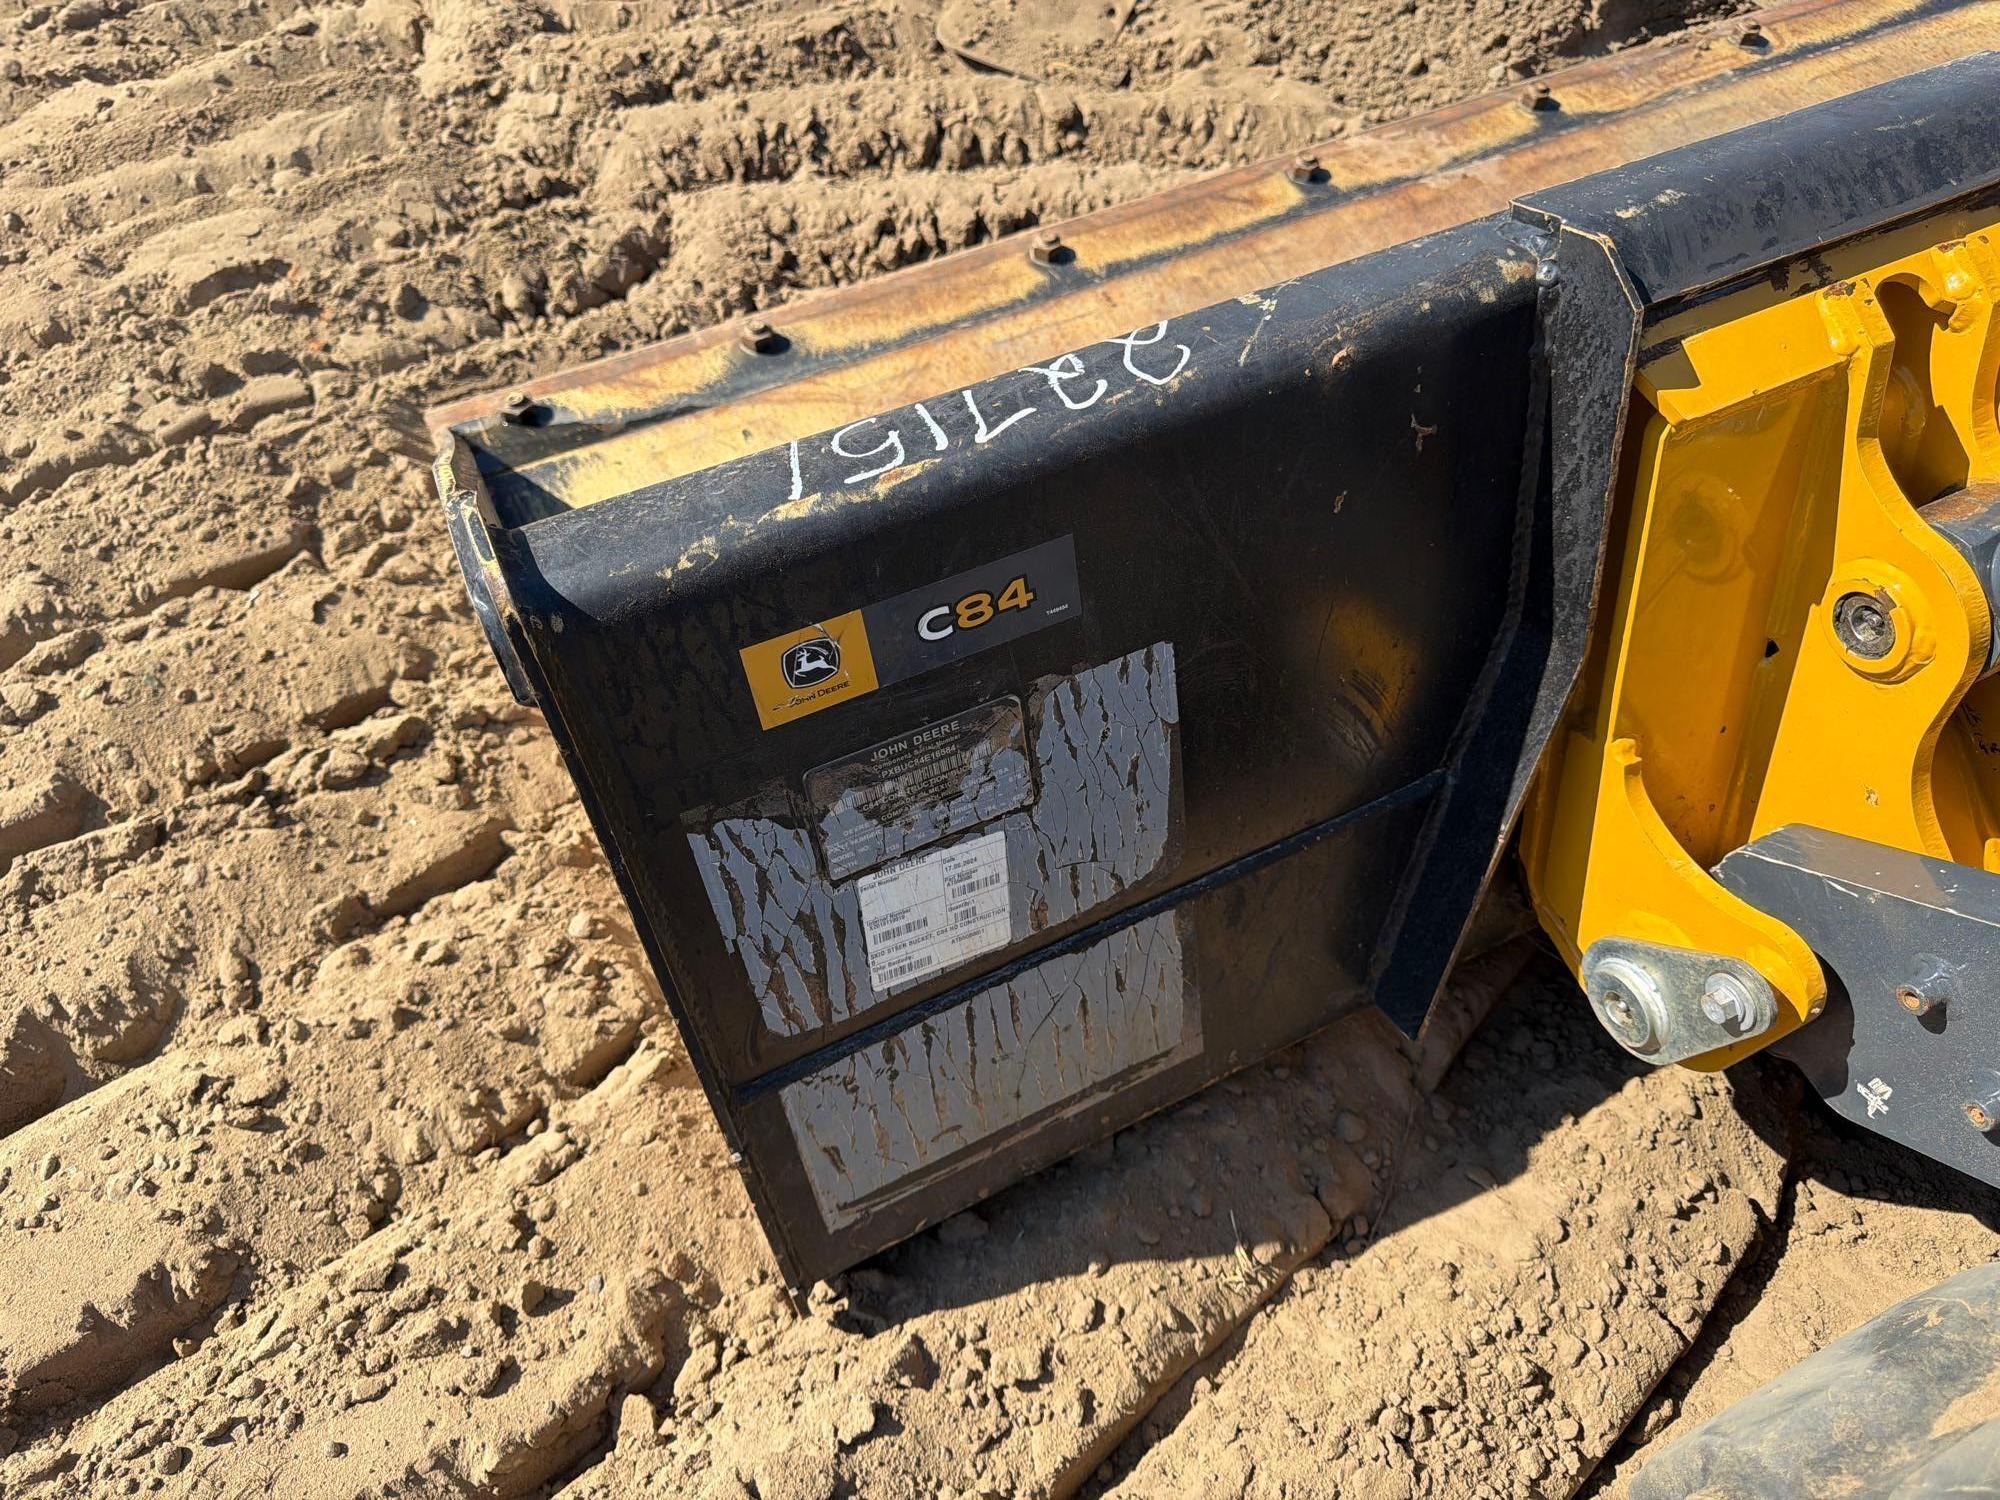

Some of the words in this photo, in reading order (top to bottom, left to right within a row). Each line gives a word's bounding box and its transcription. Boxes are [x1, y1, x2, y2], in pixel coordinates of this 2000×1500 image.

[919, 576, 1035, 642] C84
[817, 681, 850, 697] DEERE
[870, 740, 908, 763] JOHN
[913, 720, 960, 747] DEERE
[872, 865, 896, 881] JOHN
[900, 857, 927, 871] DEERE
